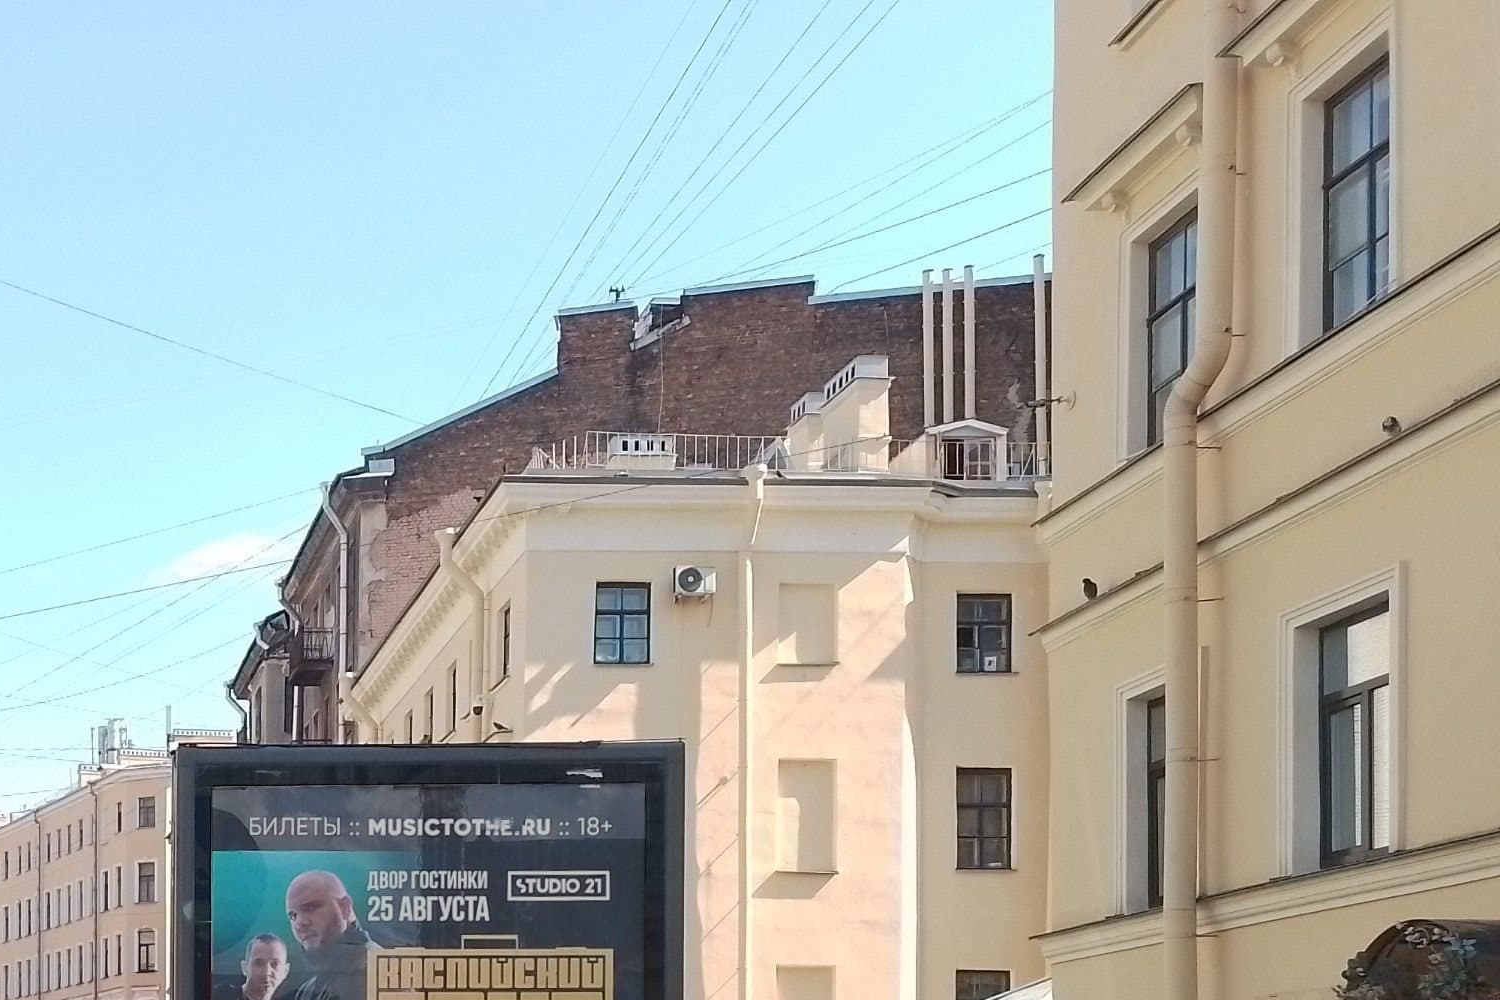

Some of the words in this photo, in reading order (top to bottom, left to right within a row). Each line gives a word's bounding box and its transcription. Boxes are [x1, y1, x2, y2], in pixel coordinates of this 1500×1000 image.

[248, 816, 341, 837] БИЛЕТЫ
[367, 817, 552, 837] MUSICTOTHE.RU
[577, 816, 613, 837] 18+
[367, 870, 408, 891] ДВОР
[411, 870, 488, 890] ГОСТИНКИ
[515, 878, 579, 895] STUDIO
[584, 878, 602, 895] 21
[367, 896, 394, 922] 25
[398, 896, 490, 922] АВГУСТА
[377, 956, 604, 990] КАСПИЙСКИЙ
